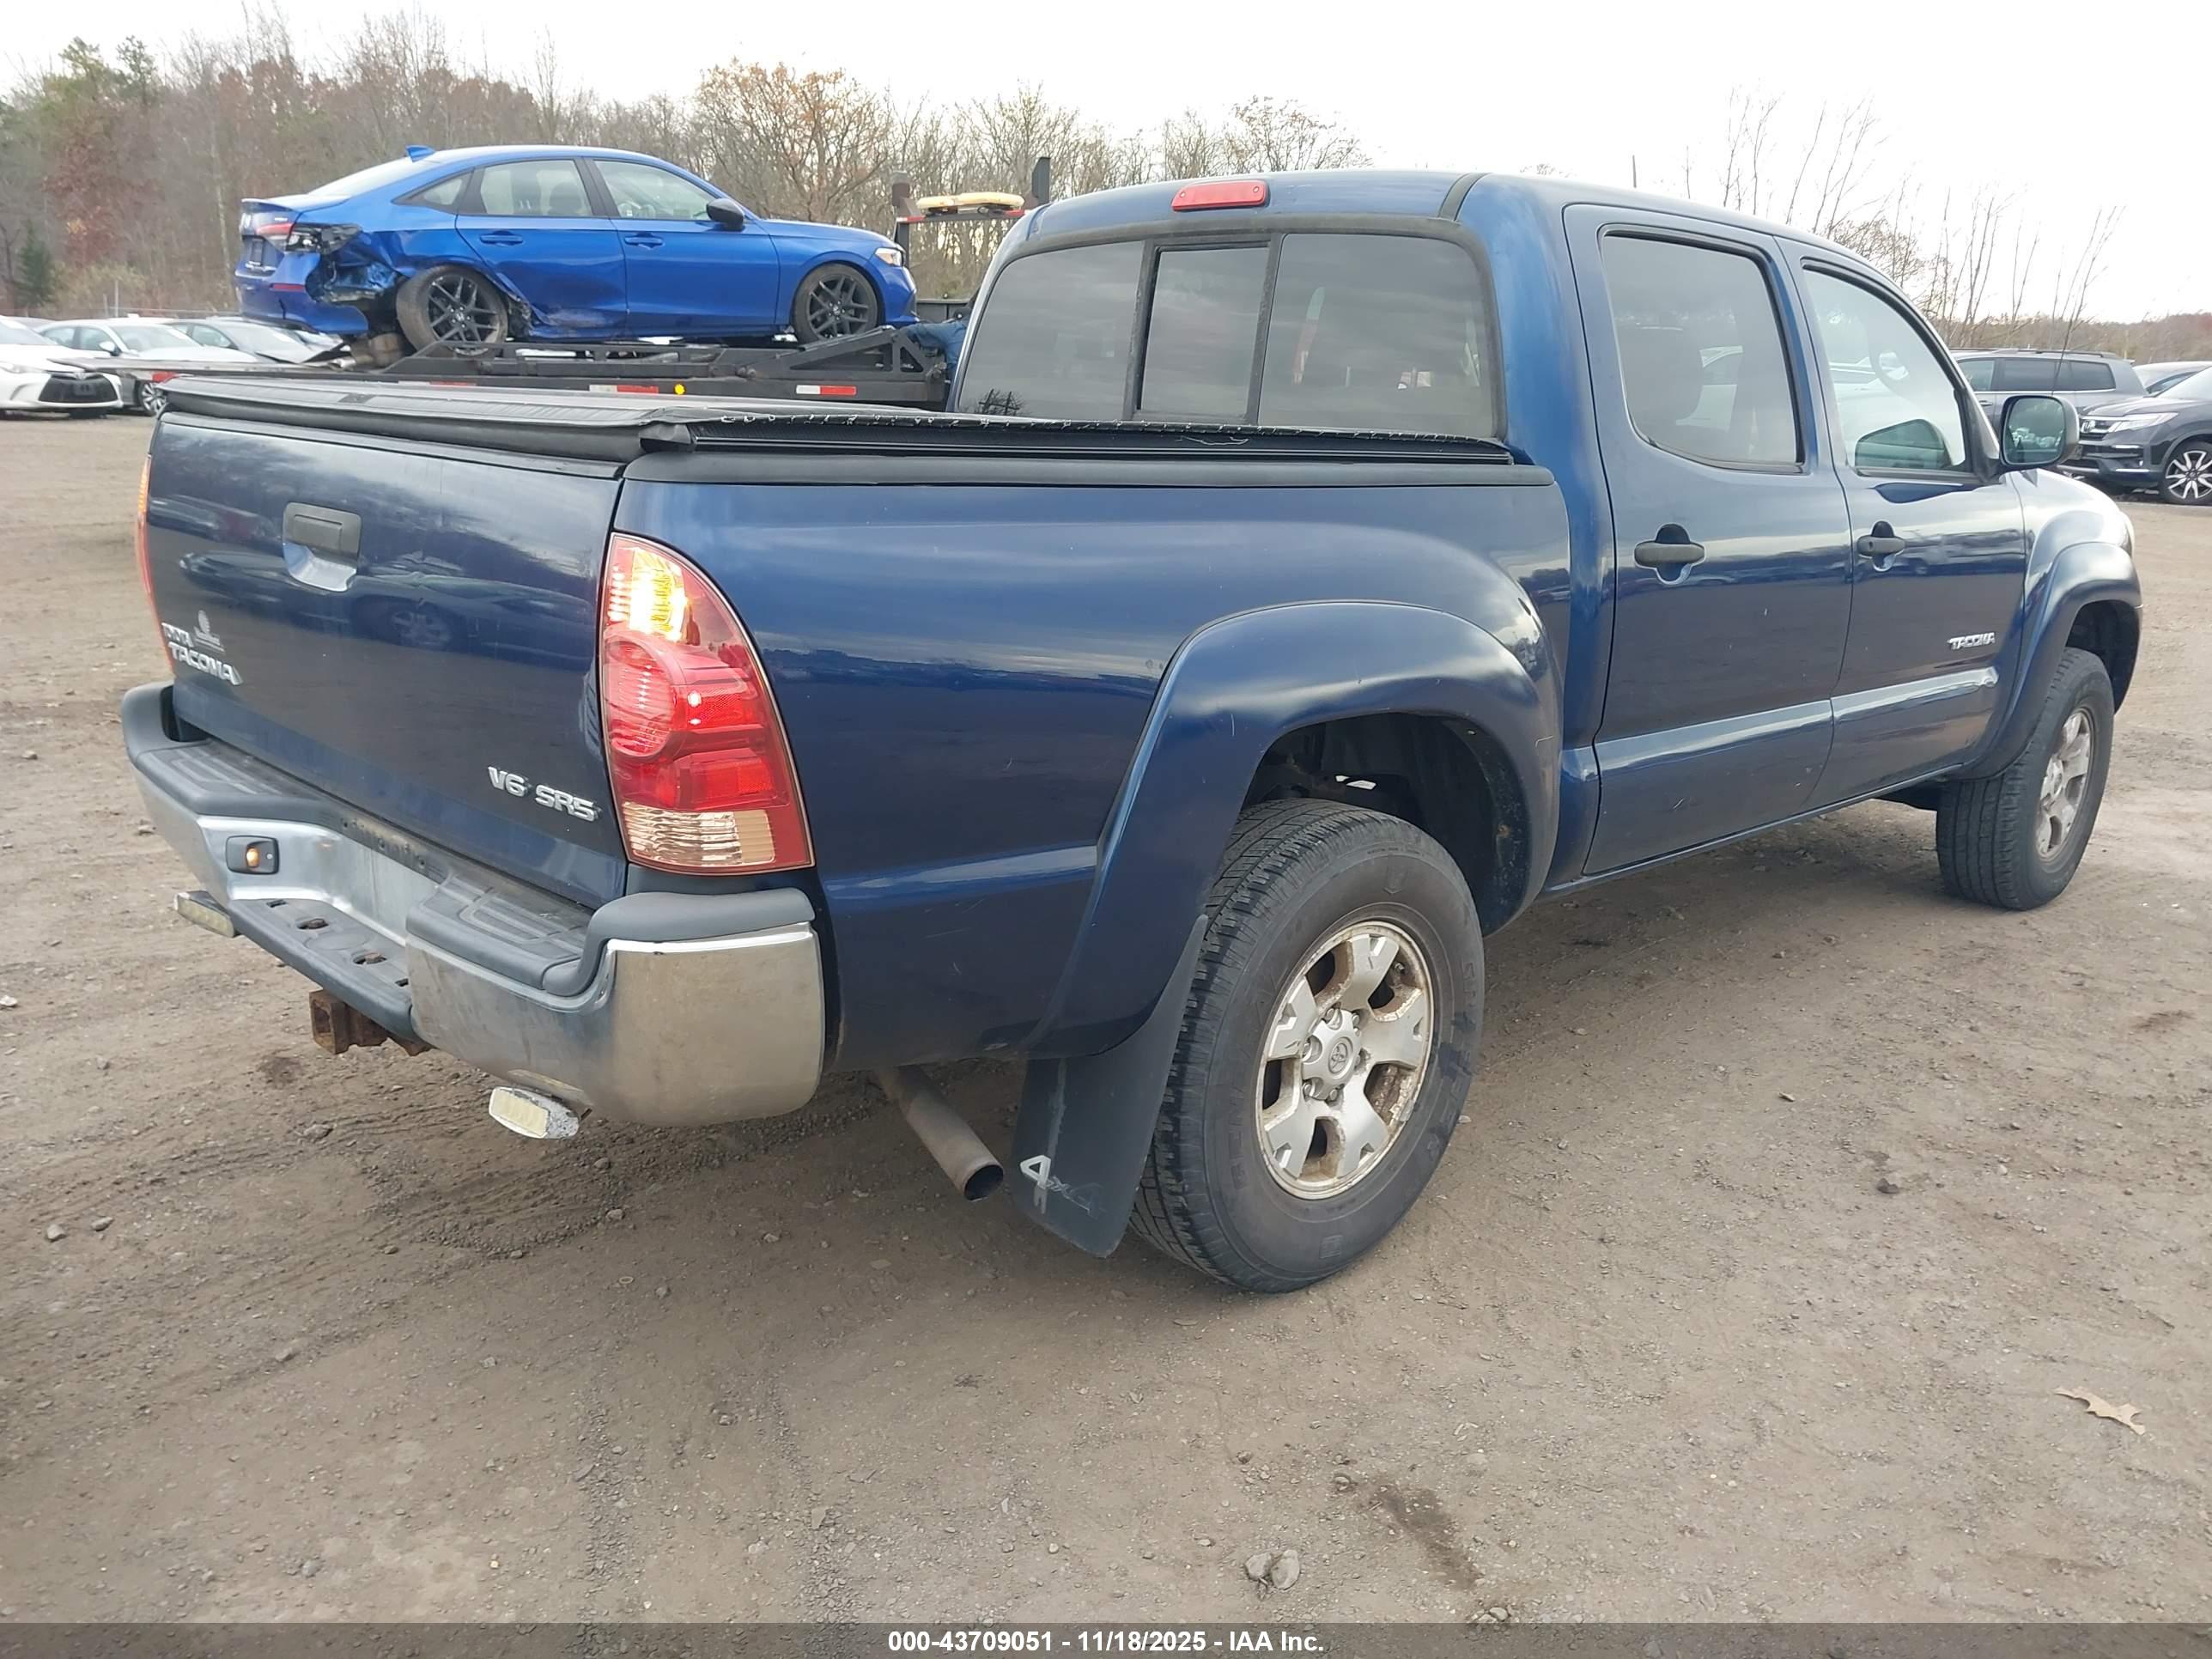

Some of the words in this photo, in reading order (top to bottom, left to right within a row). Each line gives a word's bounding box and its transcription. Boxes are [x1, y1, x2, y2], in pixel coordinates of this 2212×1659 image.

[168, 641, 242, 685] TACOMA
[488, 765, 529, 797] V6
[535, 784, 599, 822] SR5
